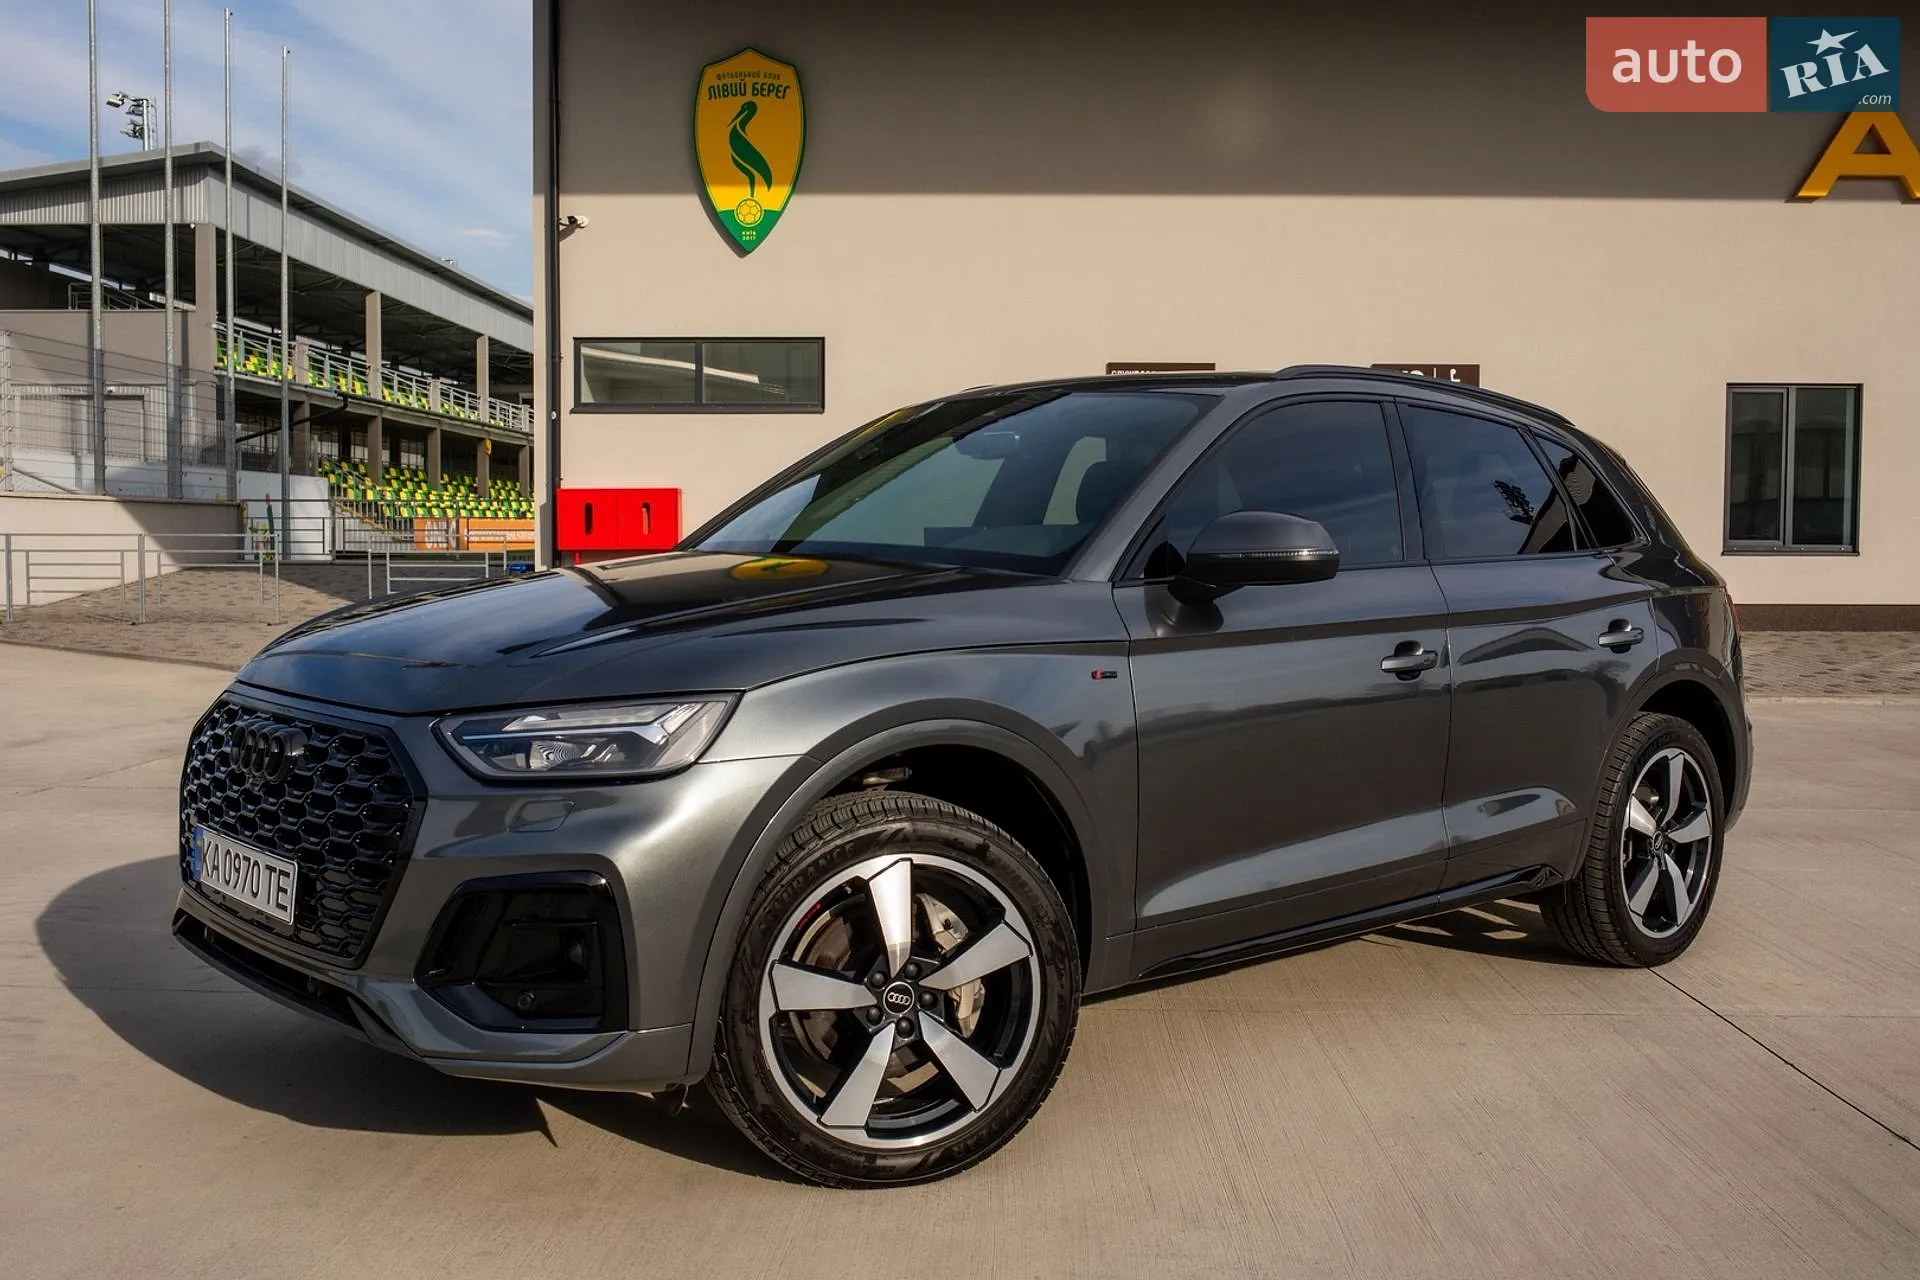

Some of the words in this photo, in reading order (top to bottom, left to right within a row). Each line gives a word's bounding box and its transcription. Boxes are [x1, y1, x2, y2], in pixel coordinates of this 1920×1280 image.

[707, 79, 747, 101] ЛІВИЙ
[752, 81, 792, 100] БЕРЕГ
[202, 838, 221, 883] KA
[224, 848, 261, 899] 0970
[265, 863, 291, 913] TE
